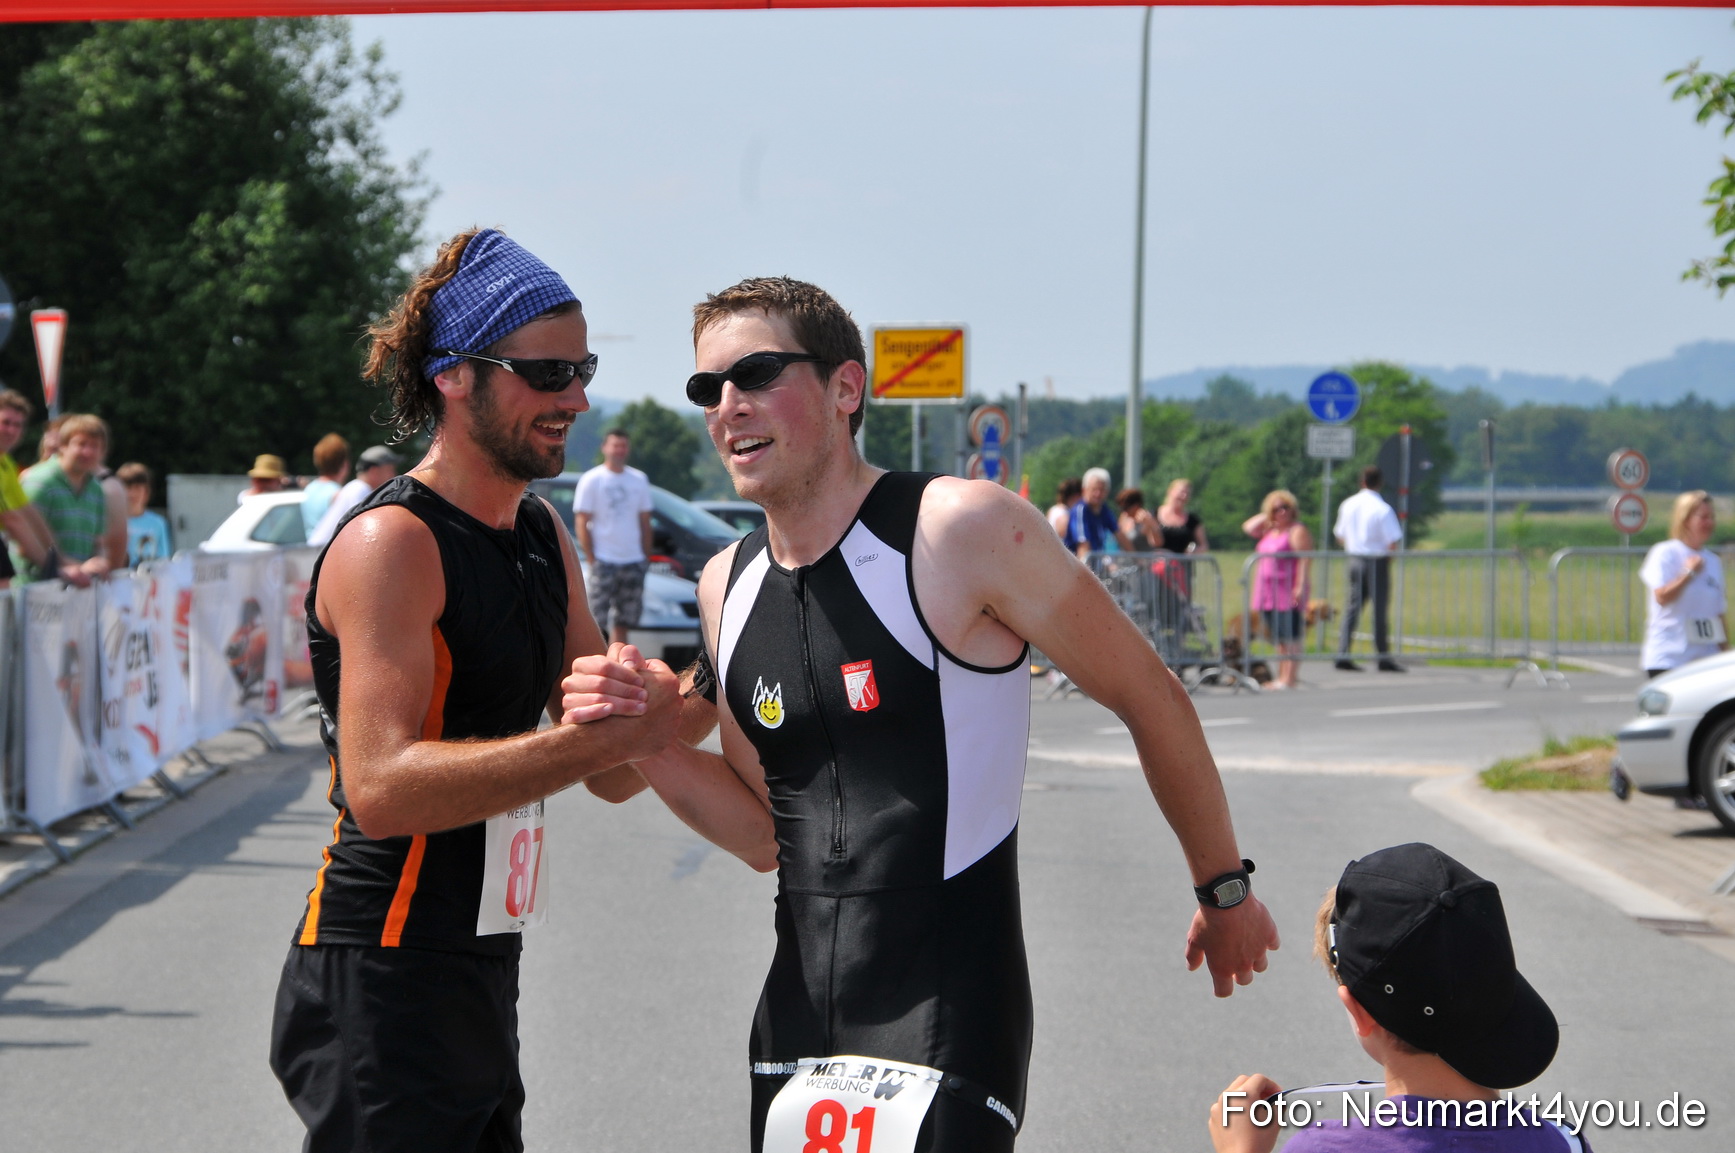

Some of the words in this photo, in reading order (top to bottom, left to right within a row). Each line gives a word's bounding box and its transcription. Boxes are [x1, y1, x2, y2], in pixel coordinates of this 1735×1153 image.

[1621, 461, 1642, 480] 60
[1695, 619, 1714, 638] 10
[505, 826, 543, 917] 87
[810, 1062, 877, 1081] MEYER
[806, 1078, 871, 1094] WERBUNG
[803, 1099, 877, 1153] 81
